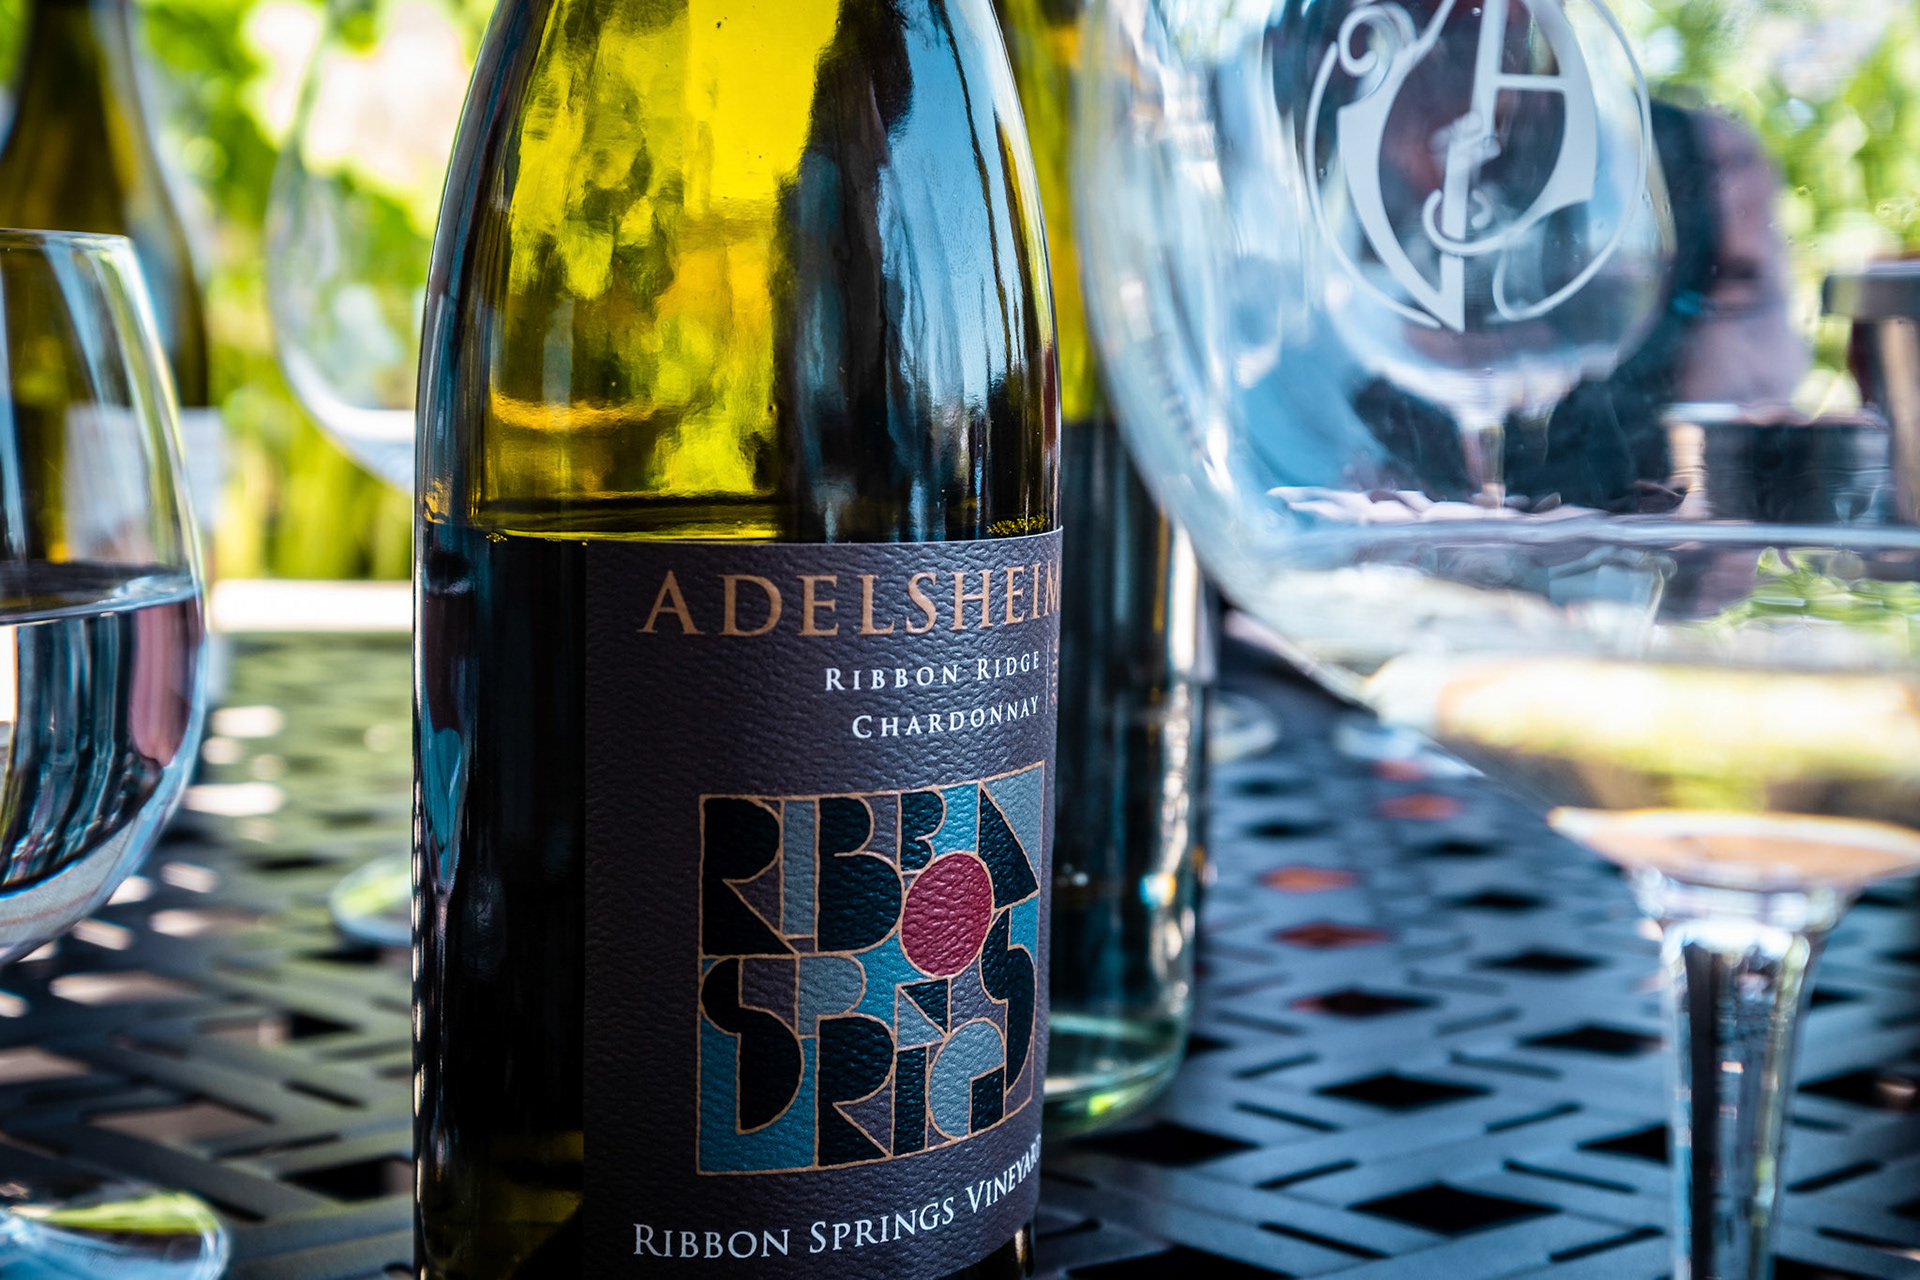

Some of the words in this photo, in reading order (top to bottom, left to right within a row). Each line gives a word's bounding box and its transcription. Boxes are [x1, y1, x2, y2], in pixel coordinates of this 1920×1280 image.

[637, 554, 1060, 638] ADELSHEIM
[826, 664, 959, 692] RIBBON
[976, 650, 1040, 681] RIDGE
[852, 694, 1039, 739] CHARDONNAY
[633, 1224, 790, 1260] RIBBON
[808, 1196, 955, 1254] SPRINGS
